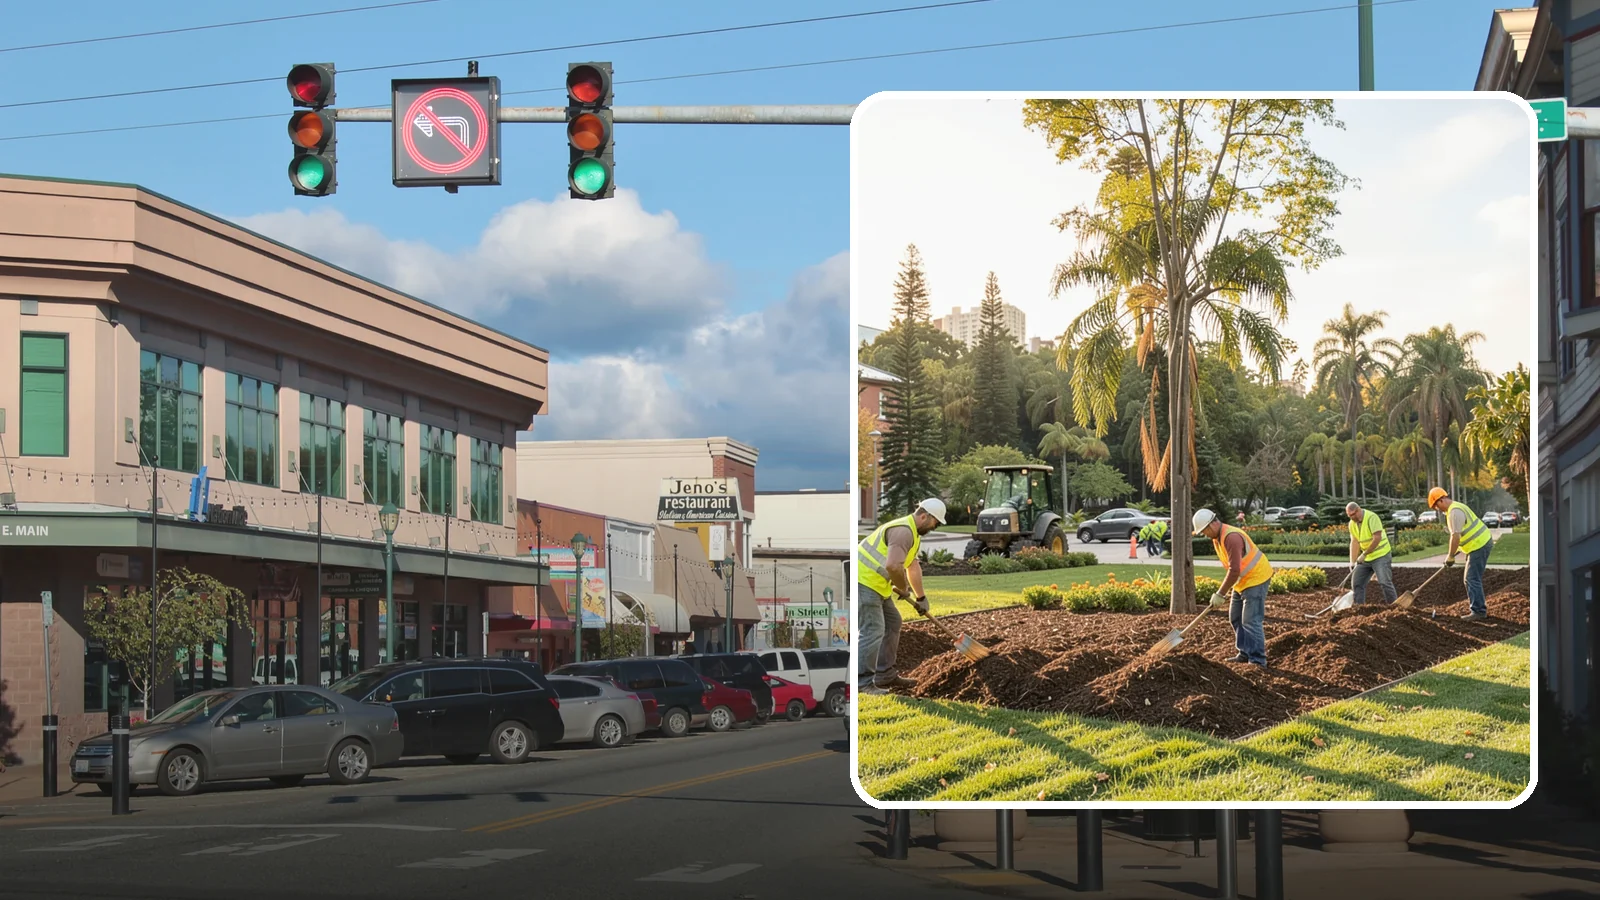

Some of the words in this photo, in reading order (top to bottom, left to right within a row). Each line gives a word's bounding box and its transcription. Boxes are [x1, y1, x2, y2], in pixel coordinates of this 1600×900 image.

[670, 480, 727, 494] Jeno's
[665, 496, 731, 509] restaurant
[659, 510, 681, 519] Italian
[686, 509, 714, 519] American
[715, 509, 738, 519] Cuisine
[2, 525, 13, 536] E.
[15, 525, 49, 536] MAIN
[797, 608, 828, 616] Street
[791, 619, 823, 627] lass
